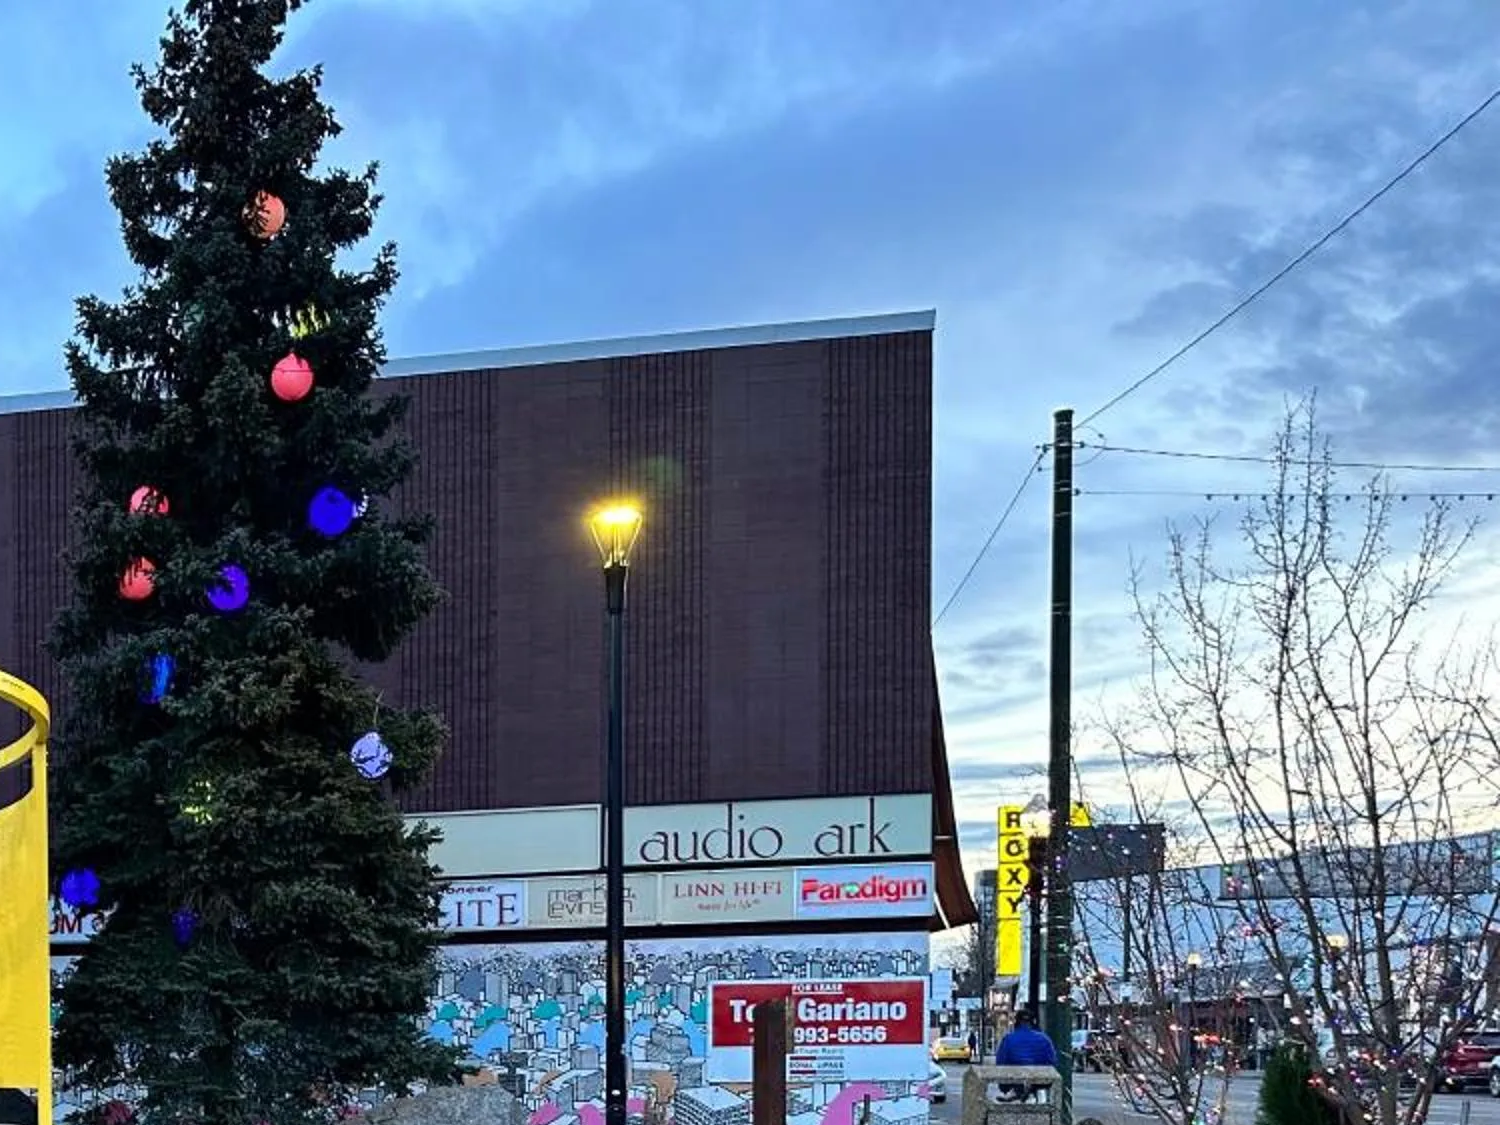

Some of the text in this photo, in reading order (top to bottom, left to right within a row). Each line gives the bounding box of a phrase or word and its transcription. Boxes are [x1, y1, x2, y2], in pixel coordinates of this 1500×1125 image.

[640, 797, 893, 863] audio ark
[1006, 811, 1023, 914] ROXY
[674, 880, 781, 898] LINN HI-FI
[801, 876, 927, 902] Paradigm
[440, 893, 521, 927] ITE
[797, 997, 907, 1022] Gariano
